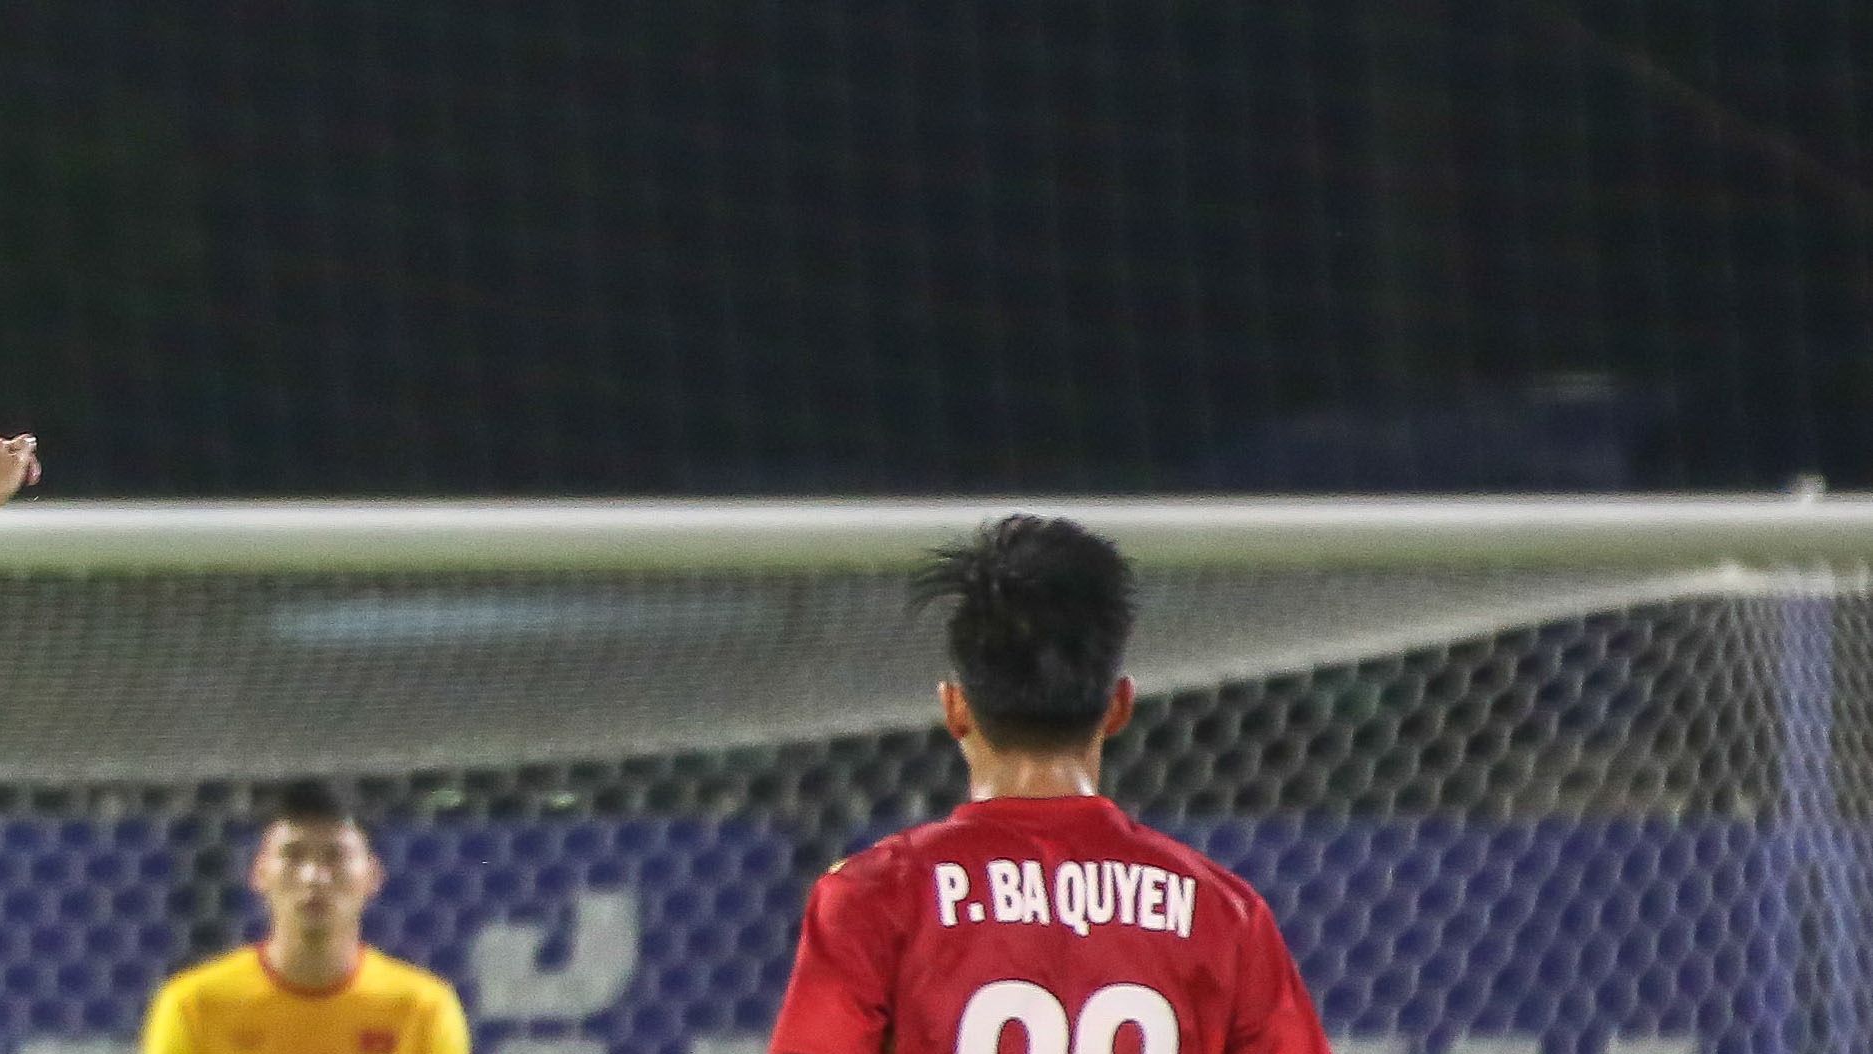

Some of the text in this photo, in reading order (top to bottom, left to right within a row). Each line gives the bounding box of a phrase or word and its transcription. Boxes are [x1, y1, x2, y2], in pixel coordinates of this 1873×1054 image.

[934, 859, 1196, 938] P. BA QUYEN
